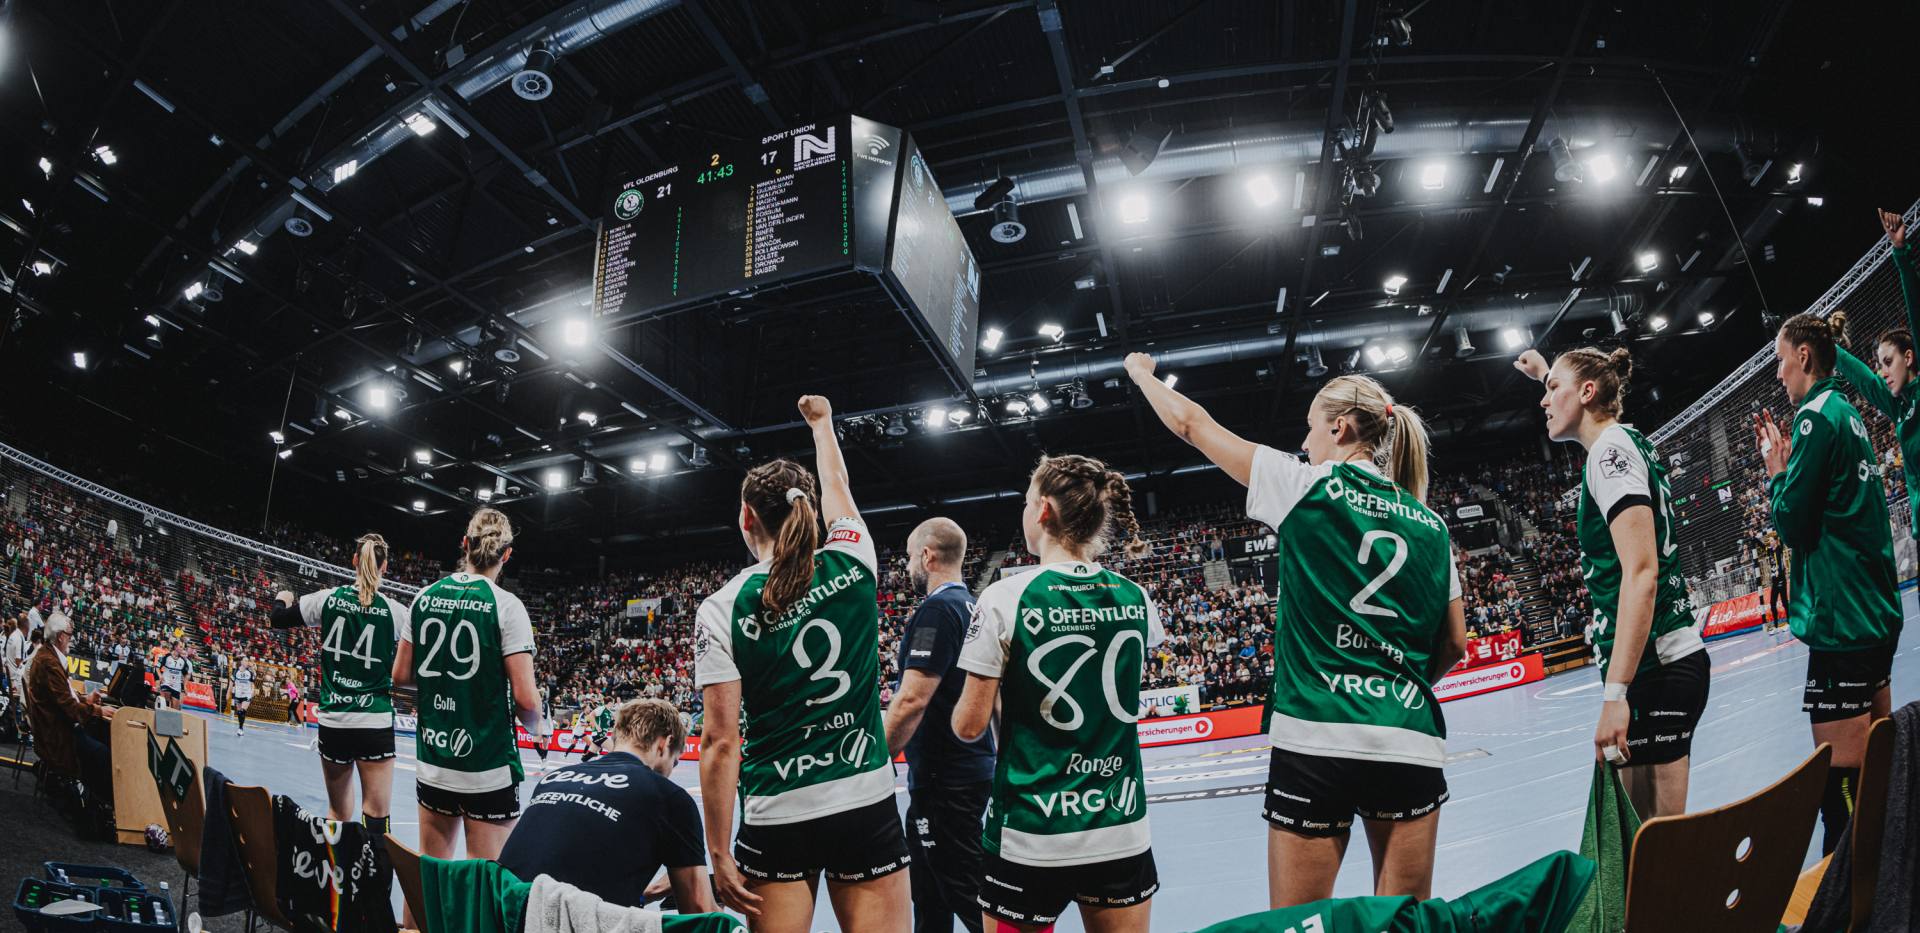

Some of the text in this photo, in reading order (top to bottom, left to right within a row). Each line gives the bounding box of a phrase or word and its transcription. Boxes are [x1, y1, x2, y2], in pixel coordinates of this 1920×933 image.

[762, 124, 816, 144] SPORT UNION
[711, 154, 720, 166] 2
[761, 150, 777, 165] 17
[868, 156, 892, 165] HOTSPOT
[635, 166, 678, 186] OLDENBURG
[697, 165, 733, 184] 41:43
[656, 183, 671, 199] 21
[1345, 486, 1440, 532] ÖFFENTLICHE
[1245, 537, 1275, 553] EWE
[298, 565, 319, 579] EWE
[1349, 530, 1408, 618] 2
[431, 596, 494, 613] ÖFFENTLICHE
[762, 566, 864, 625] ÖFENTLICHE
[337, 598, 389, 617] ÖFFENTLICHE
[769, 608, 812, 633] OLDENBURG
[1051, 624, 1096, 632] OLDENBURG
[322, 615, 382, 670] 44
[418, 617, 481, 680] 29
[1336, 624, 1404, 665] Bortta
[792, 618, 851, 707] 3
[1027, 630, 1145, 731] 80
[1320, 671, 1386, 698] VRG
[434, 693, 456, 712] Golla
[1818, 702, 1837, 710] Kempa
[421, 726, 448, 748] VRG
[1655, 734, 1677, 742] Kempa
[169, 743, 192, 786] T
[1066, 752, 1123, 777] Ronge
[540, 770, 630, 788] cewe
[1033, 789, 1105, 818] VRG
[1271, 810, 1295, 825] Kempa
[1302, 820, 1330, 829] Kempa
[1376, 811, 1404, 820] Kempa
[1411, 802, 1435, 816] Kempa
[743, 864, 768, 878] Kempa
[776, 871, 803, 880] Kempa
[839, 871, 865, 880] Kempa
[871, 862, 897, 876] Kempa
[997, 905, 1025, 920] Kempa
[1108, 896, 1135, 905] Kempa
